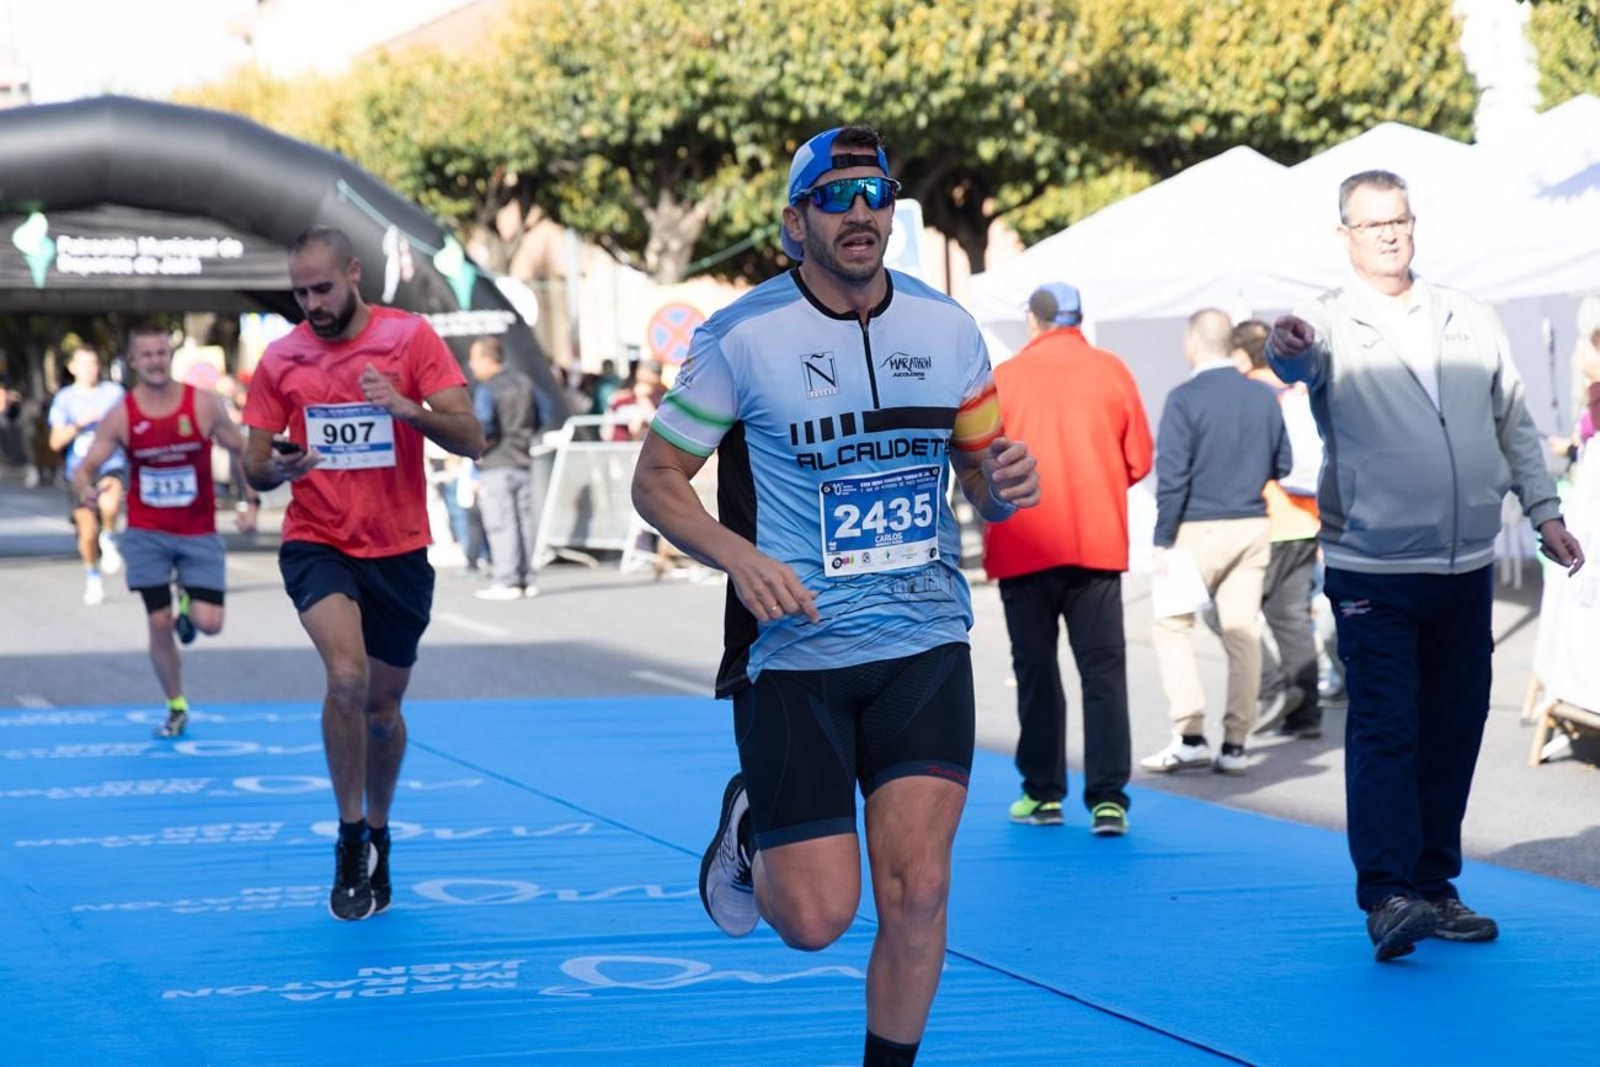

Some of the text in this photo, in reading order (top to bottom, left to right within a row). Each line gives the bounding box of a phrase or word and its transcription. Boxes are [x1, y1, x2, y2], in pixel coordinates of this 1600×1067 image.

[323, 422, 374, 444] 907
[833, 492, 933, 538] 2435
[874, 532, 903, 543] CARLOS
[278, 981, 518, 1001] MEDIA
